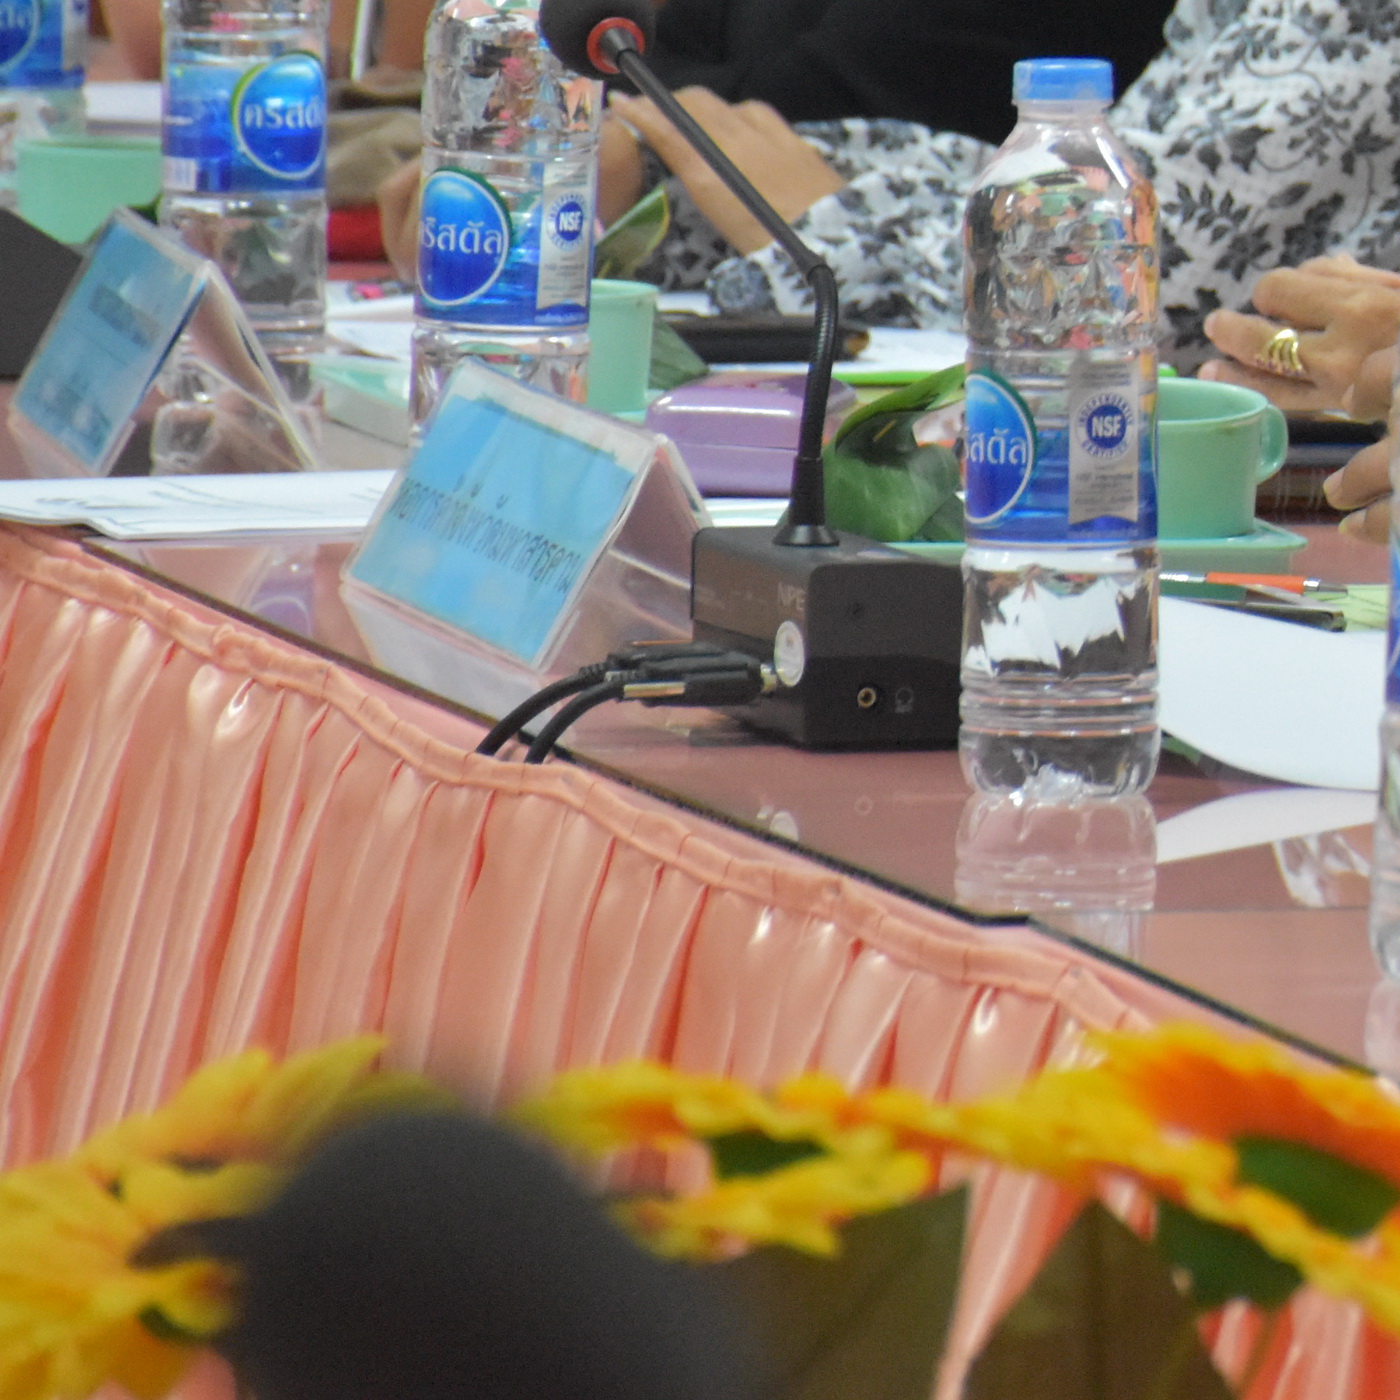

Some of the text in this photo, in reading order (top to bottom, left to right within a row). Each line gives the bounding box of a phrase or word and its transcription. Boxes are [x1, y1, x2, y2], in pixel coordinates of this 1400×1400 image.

[559, 211, 582, 233] NSF
[421, 216, 502, 255] ริสตัล
[1092, 415, 1122, 438] NSF
